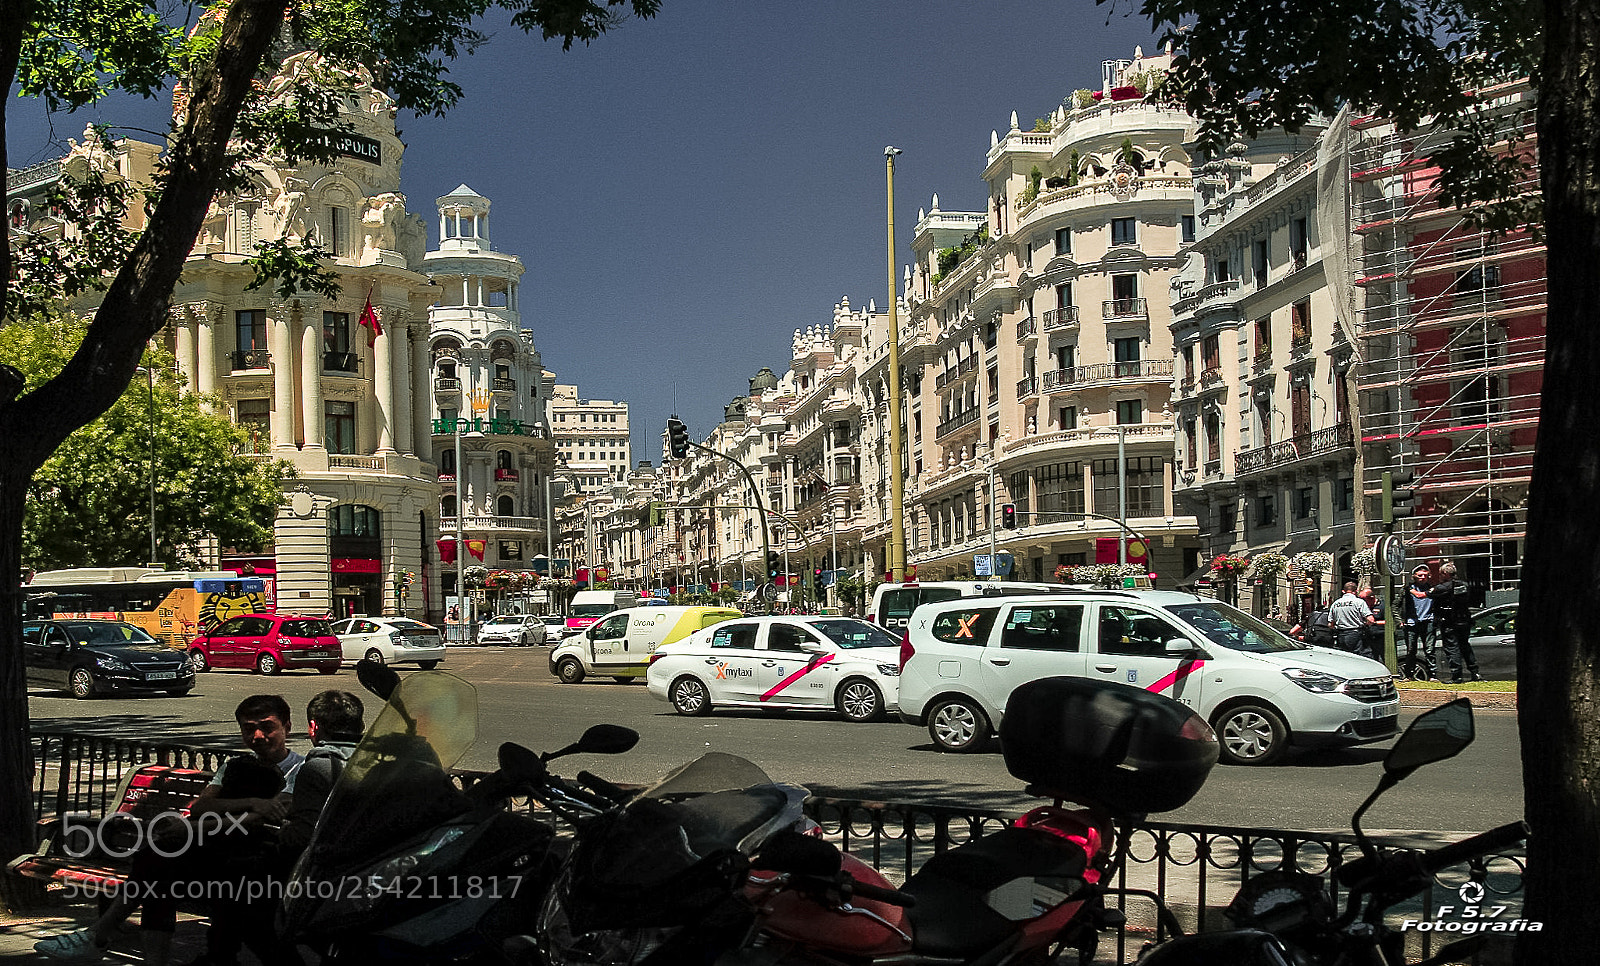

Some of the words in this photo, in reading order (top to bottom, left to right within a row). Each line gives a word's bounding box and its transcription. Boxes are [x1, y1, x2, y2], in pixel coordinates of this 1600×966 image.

[432, 417, 524, 435] ROLEX
[633, 619, 655, 627] Orona
[726, 667, 753, 679] mytaxi
